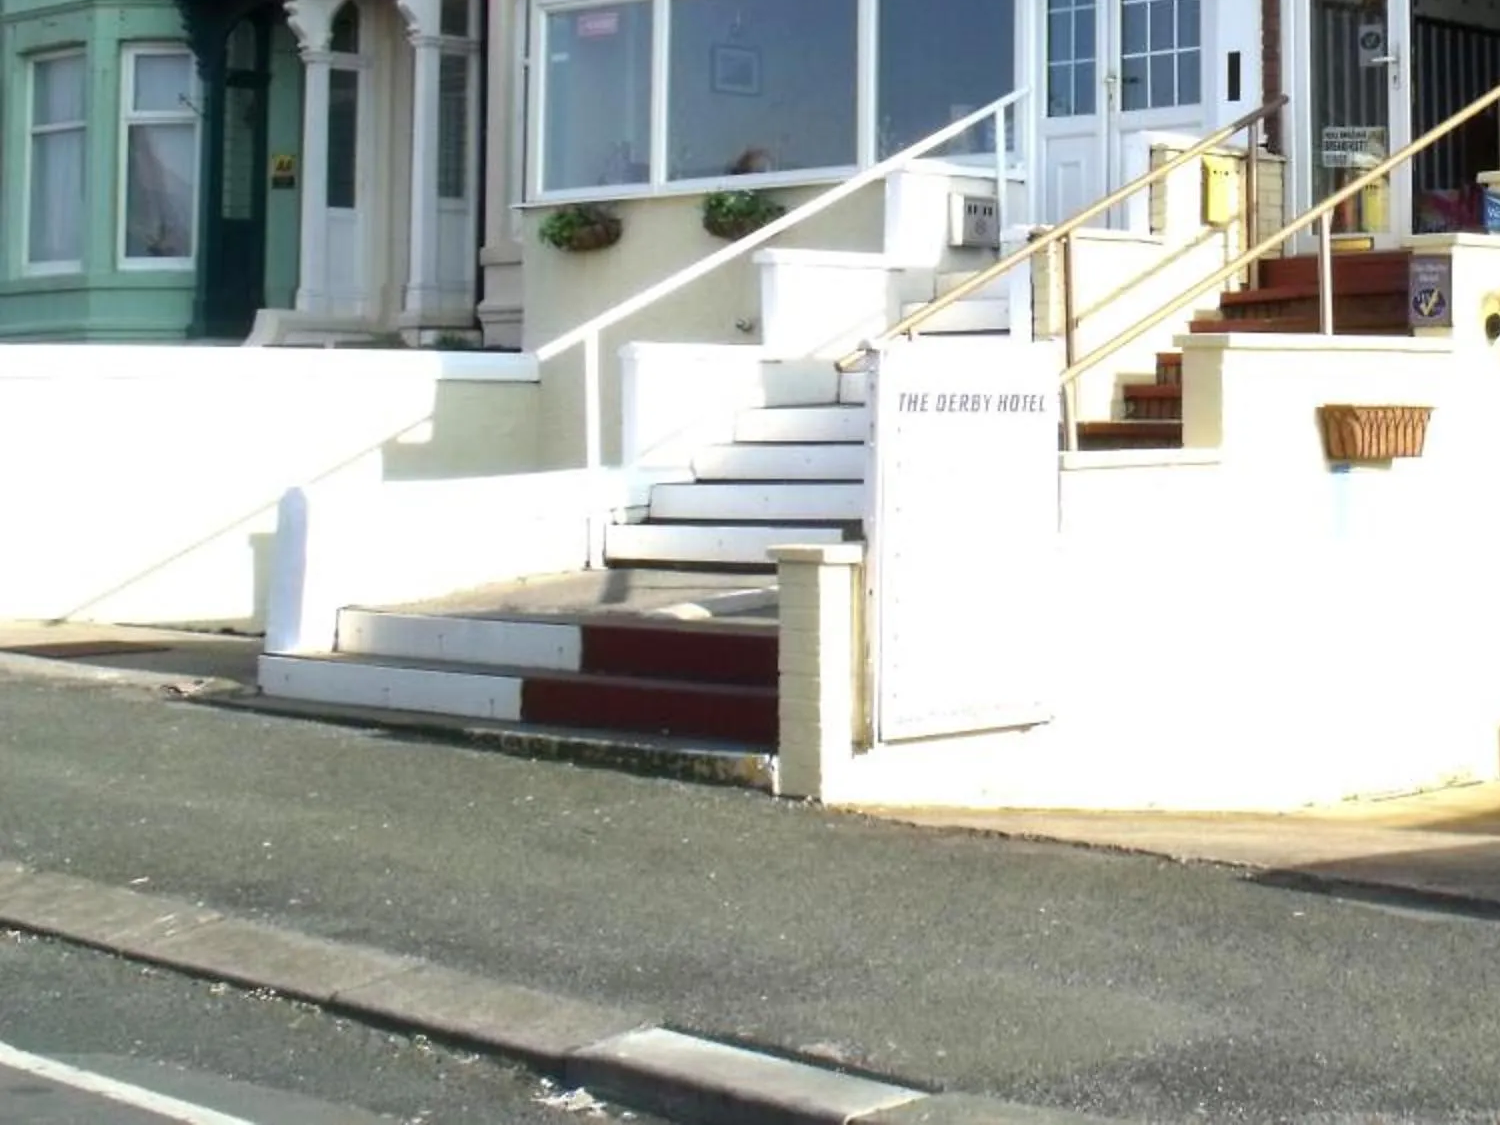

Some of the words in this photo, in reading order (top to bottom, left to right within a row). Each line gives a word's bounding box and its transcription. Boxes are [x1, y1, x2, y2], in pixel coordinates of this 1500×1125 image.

[899, 392, 929, 413] THE
[936, 393, 993, 413] DERBY
[998, 393, 1046, 413] HOTEL
